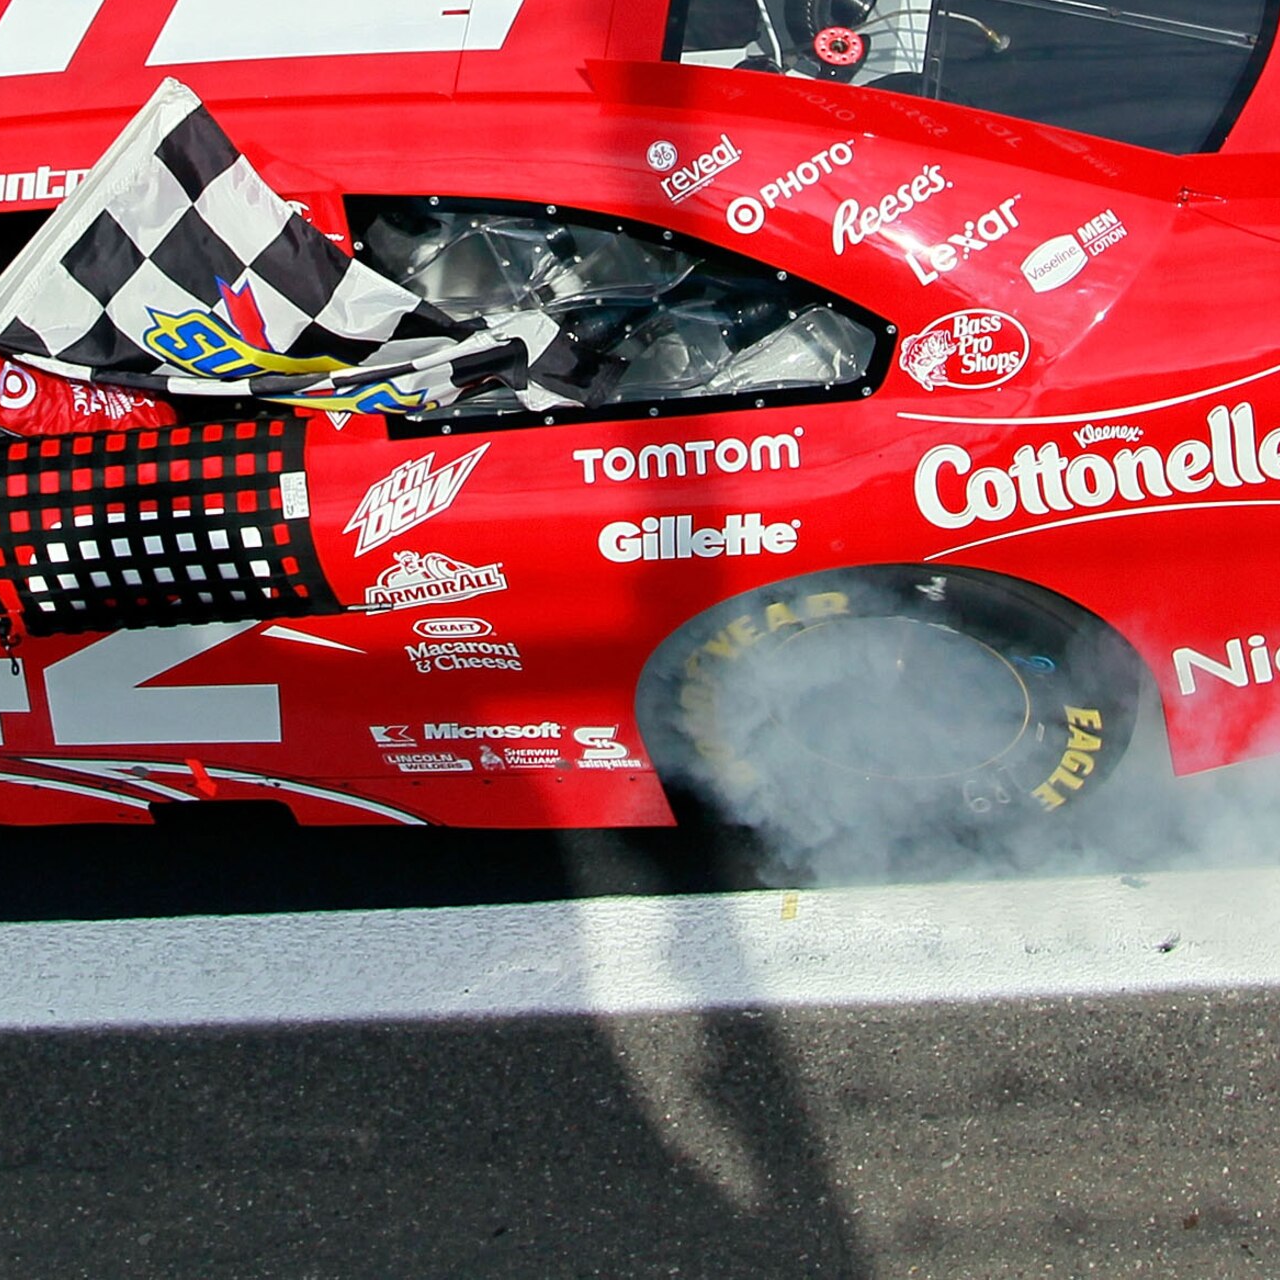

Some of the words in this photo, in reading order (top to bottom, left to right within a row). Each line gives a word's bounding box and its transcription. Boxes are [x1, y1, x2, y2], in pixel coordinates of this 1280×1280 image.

[760, 141, 853, 209] PHOTO
[832, 164, 946, 256] Reese's
[1077, 208, 1119, 244] MEN
[905, 198, 1020, 286] Lexar
[1087, 225, 1128, 257] LOTION
[1027, 245, 1081, 281] Vaseline
[952, 315, 1002, 338] Bass
[958, 335, 994, 356] Pro
[960, 349, 1020, 375] Shops
[1073, 423, 1140, 449] Kleenex
[599, 514, 799, 562] Gillette
[427, 623, 477, 634] KRAFT
[404, 641, 521, 662] Macaroni
[433, 653, 523, 673] Cheese
[424, 721, 562, 740] Microsoft
[387, 753, 454, 763] LINCOLN
[503, 747, 560, 757] SHERWIN
[1029, 704, 1104, 813] EAGLE
[406, 762, 465, 771] WELDERS
